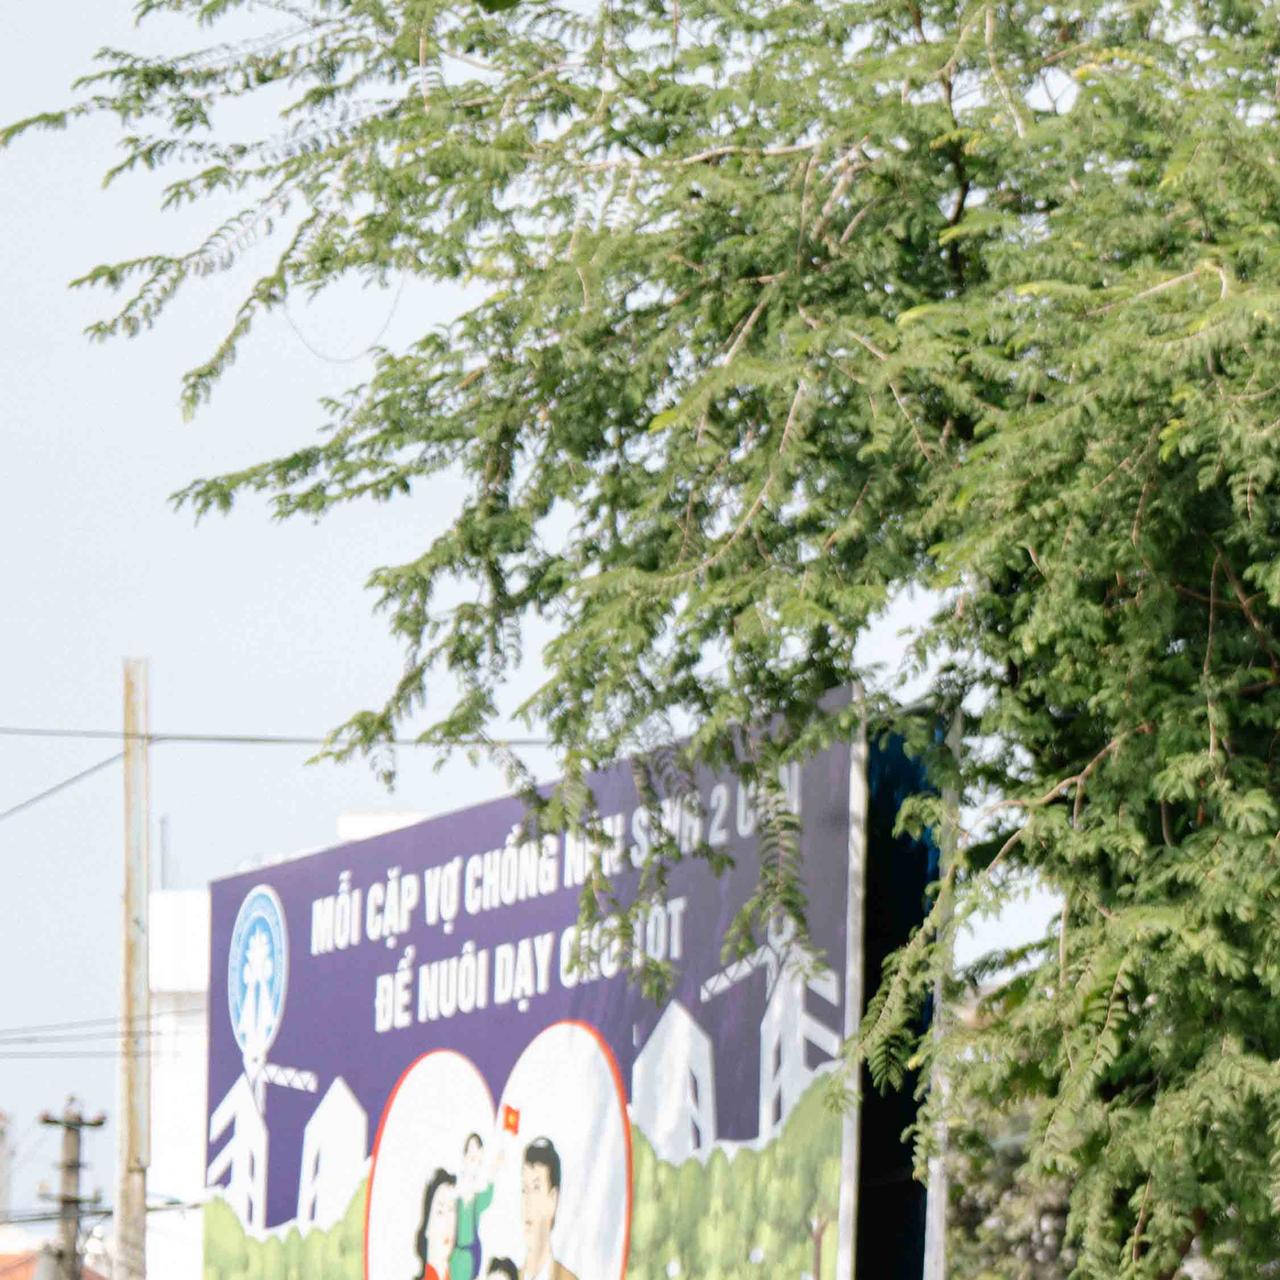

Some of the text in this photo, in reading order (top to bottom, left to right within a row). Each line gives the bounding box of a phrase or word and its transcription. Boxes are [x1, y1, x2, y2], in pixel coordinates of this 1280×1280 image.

[311, 870, 362, 956] MỖI
[366, 864, 420, 950] CẶP
[424, 856, 463, 934] VỢ
[708, 783, 730, 846] 2
[736, 760, 802, 838] CN
[374, 944, 416, 1034] ĐỂ
[418, 940, 490, 1023] NUÔI
[494, 931, 554, 1012] DẠY
